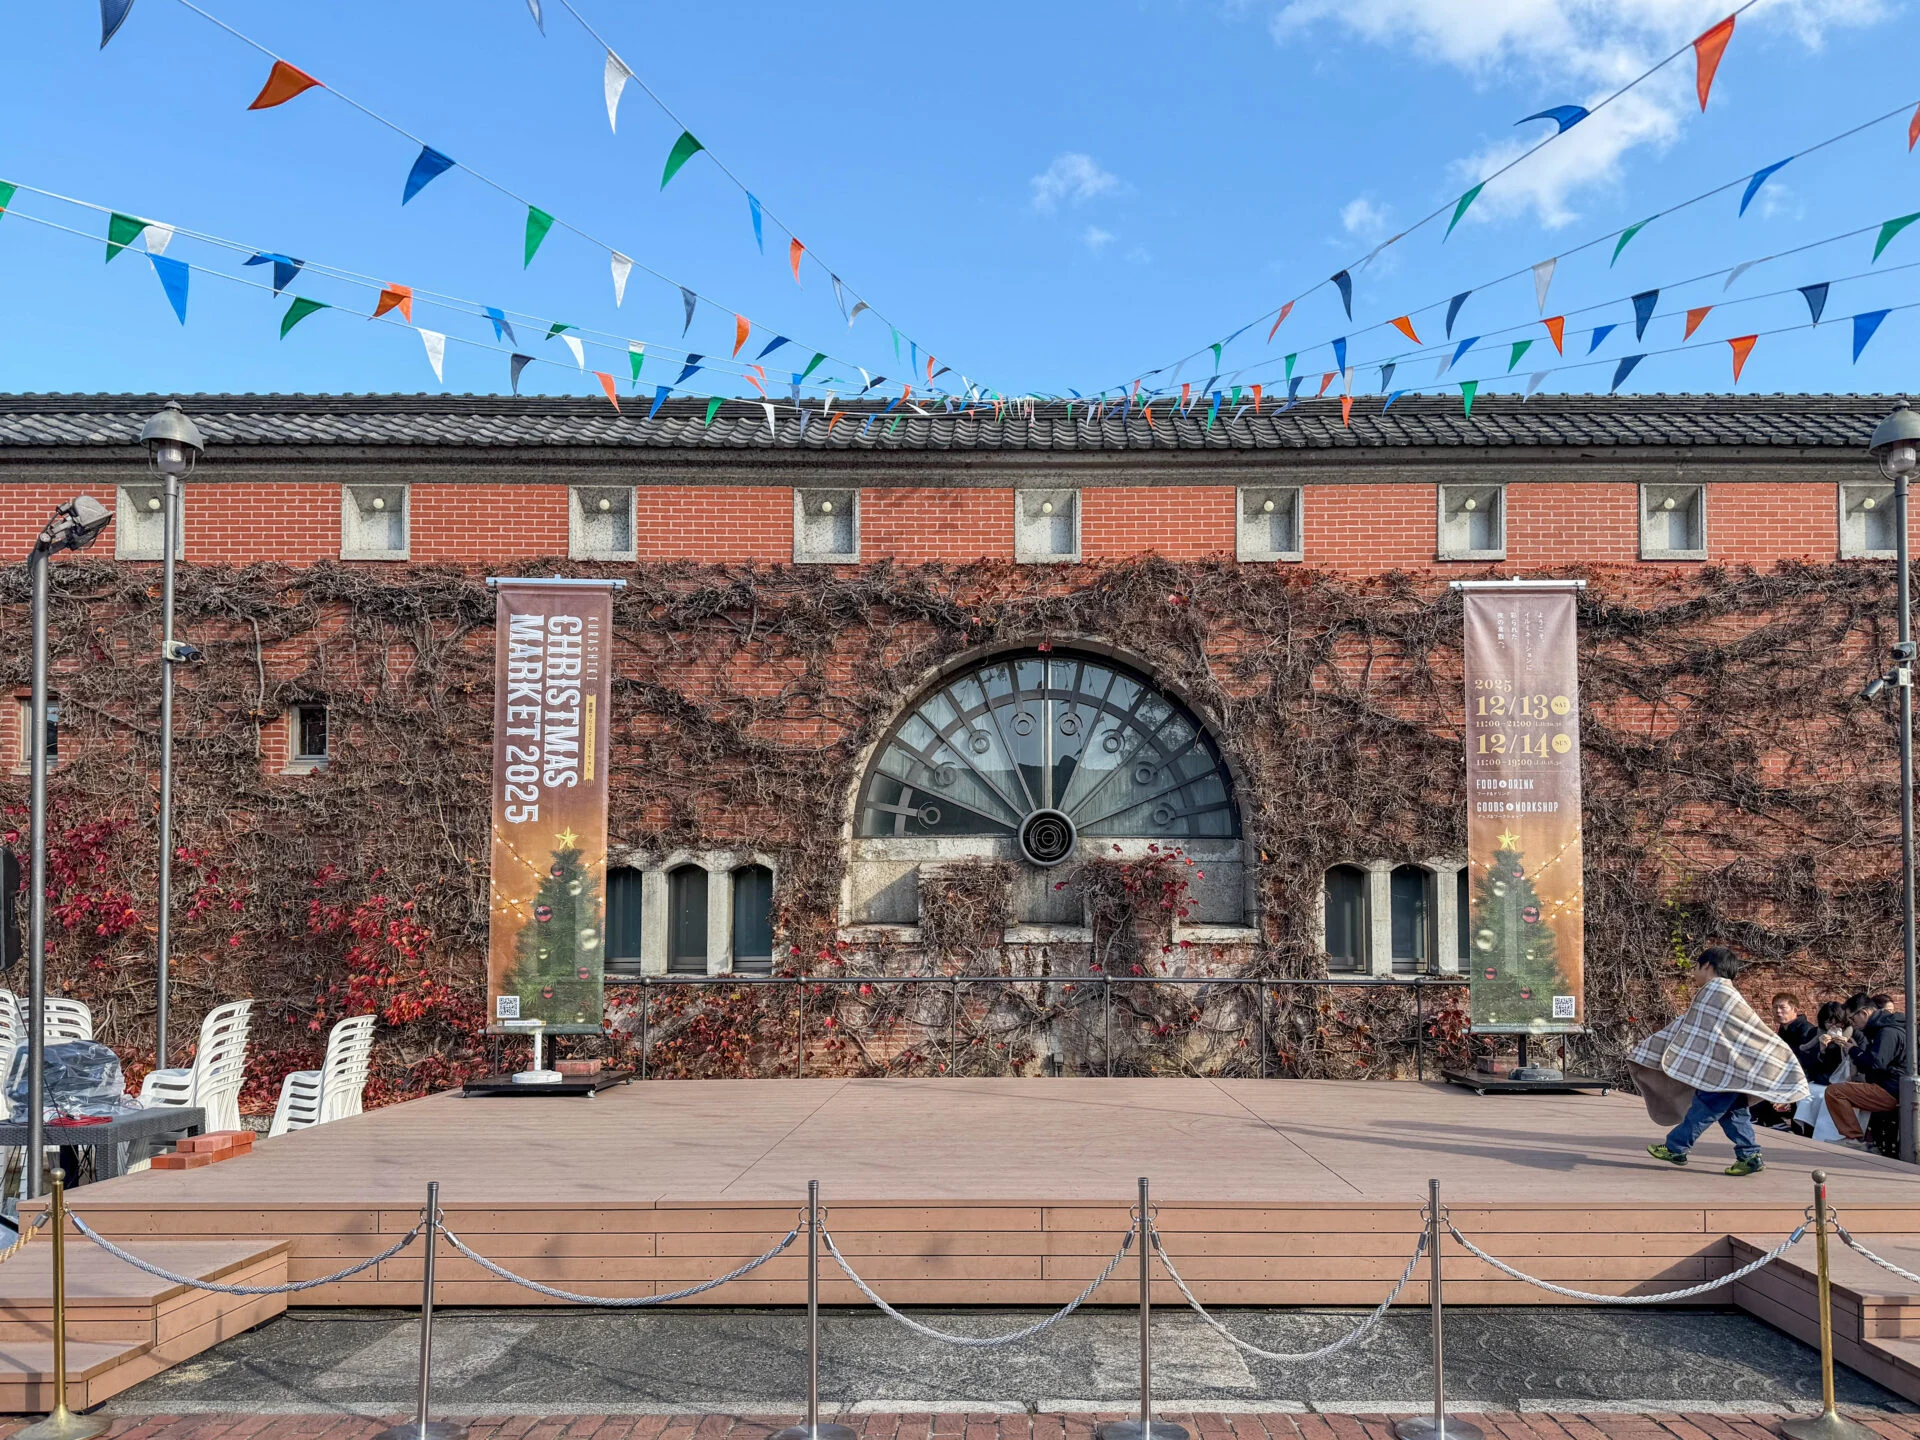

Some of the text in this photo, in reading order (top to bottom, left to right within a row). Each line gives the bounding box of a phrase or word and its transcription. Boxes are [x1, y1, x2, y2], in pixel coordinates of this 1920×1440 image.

[587, 616, 599, 681] KURASHIKI
[1474, 679, 1512, 693] 2025
[542, 614, 583, 788] CHRISTMAS
[1475, 694, 1549, 720] 12/13
[504, 613, 545, 824] MARKET 2025
[1476, 732, 1550, 758] 12/14
[1476, 778, 1498, 790] FOOD
[1508, 778, 1534, 790] DRINK
[1476, 801, 1504, 813] GOODS
[1515, 801, 1559, 813] WORKSHOP
